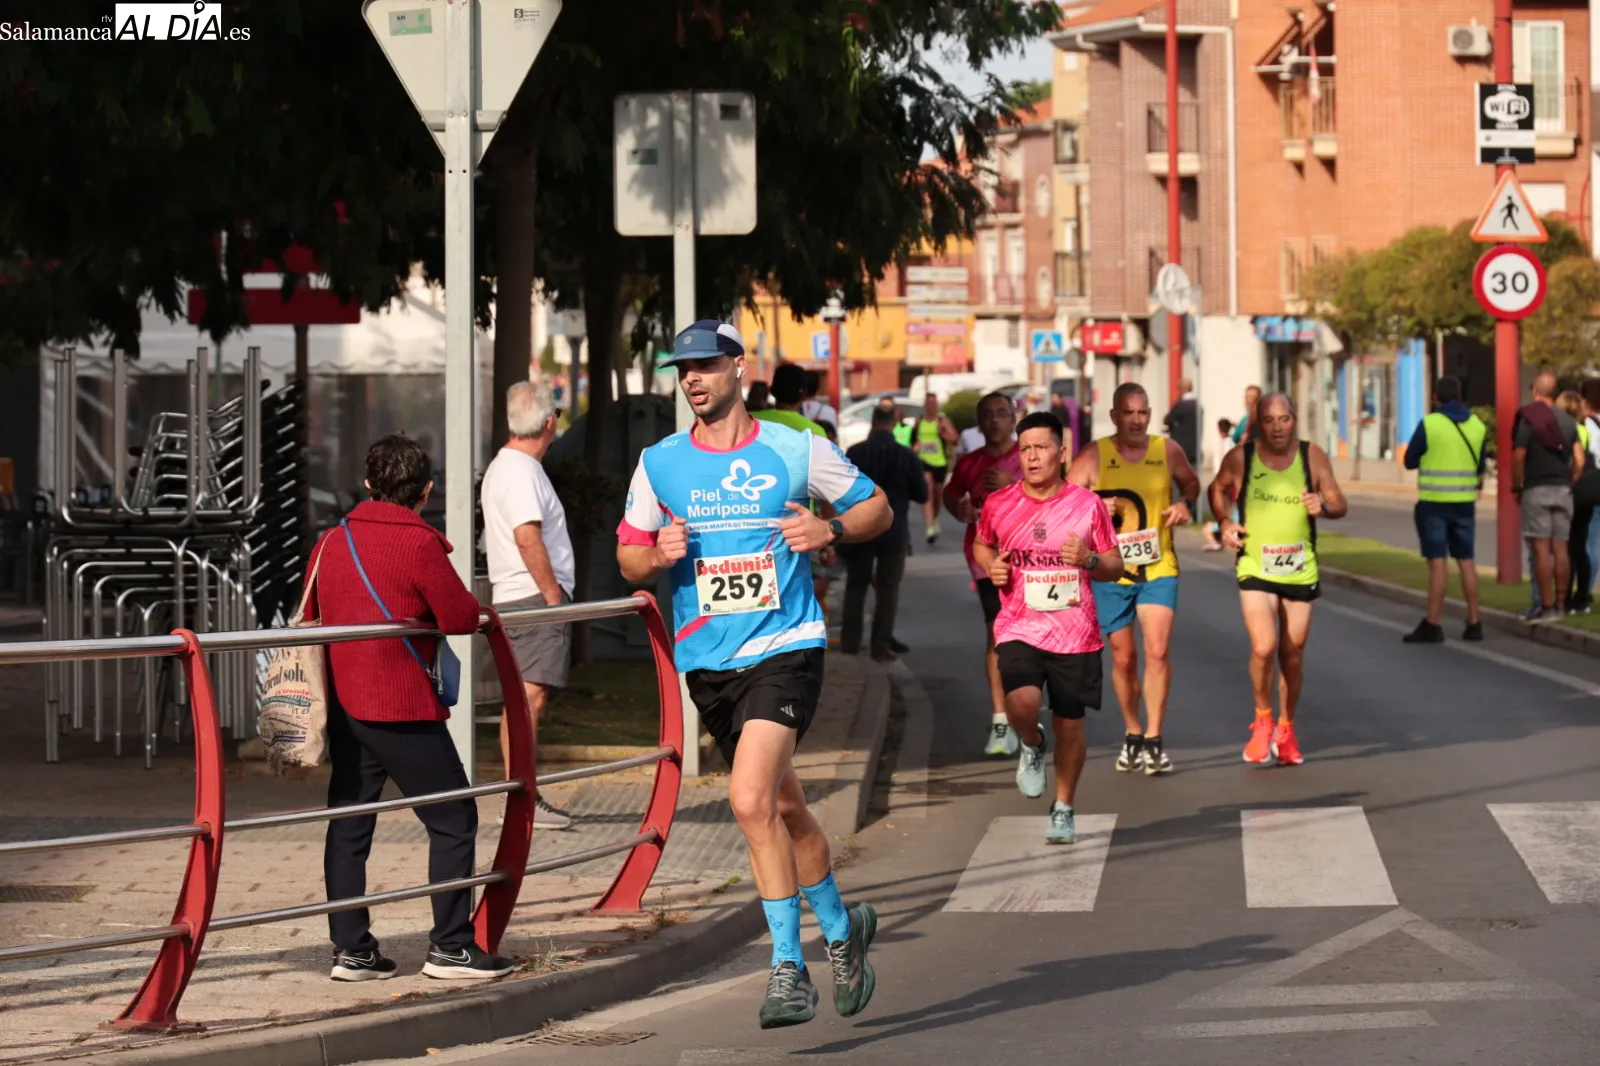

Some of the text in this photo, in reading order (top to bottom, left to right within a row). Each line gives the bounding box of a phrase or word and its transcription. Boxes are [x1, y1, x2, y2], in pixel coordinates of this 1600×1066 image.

[1490, 271, 1530, 295] 30
[690, 488, 740, 503] Piel de
[686, 502, 761, 518] Mariposa
[1122, 541, 1153, 558] 238
[1036, 556, 1064, 567] MAR
[1274, 554, 1295, 567] 44
[1026, 572, 1078, 584] bedunia
[710, 573, 763, 601] 259
[1047, 585, 1059, 601] 4
